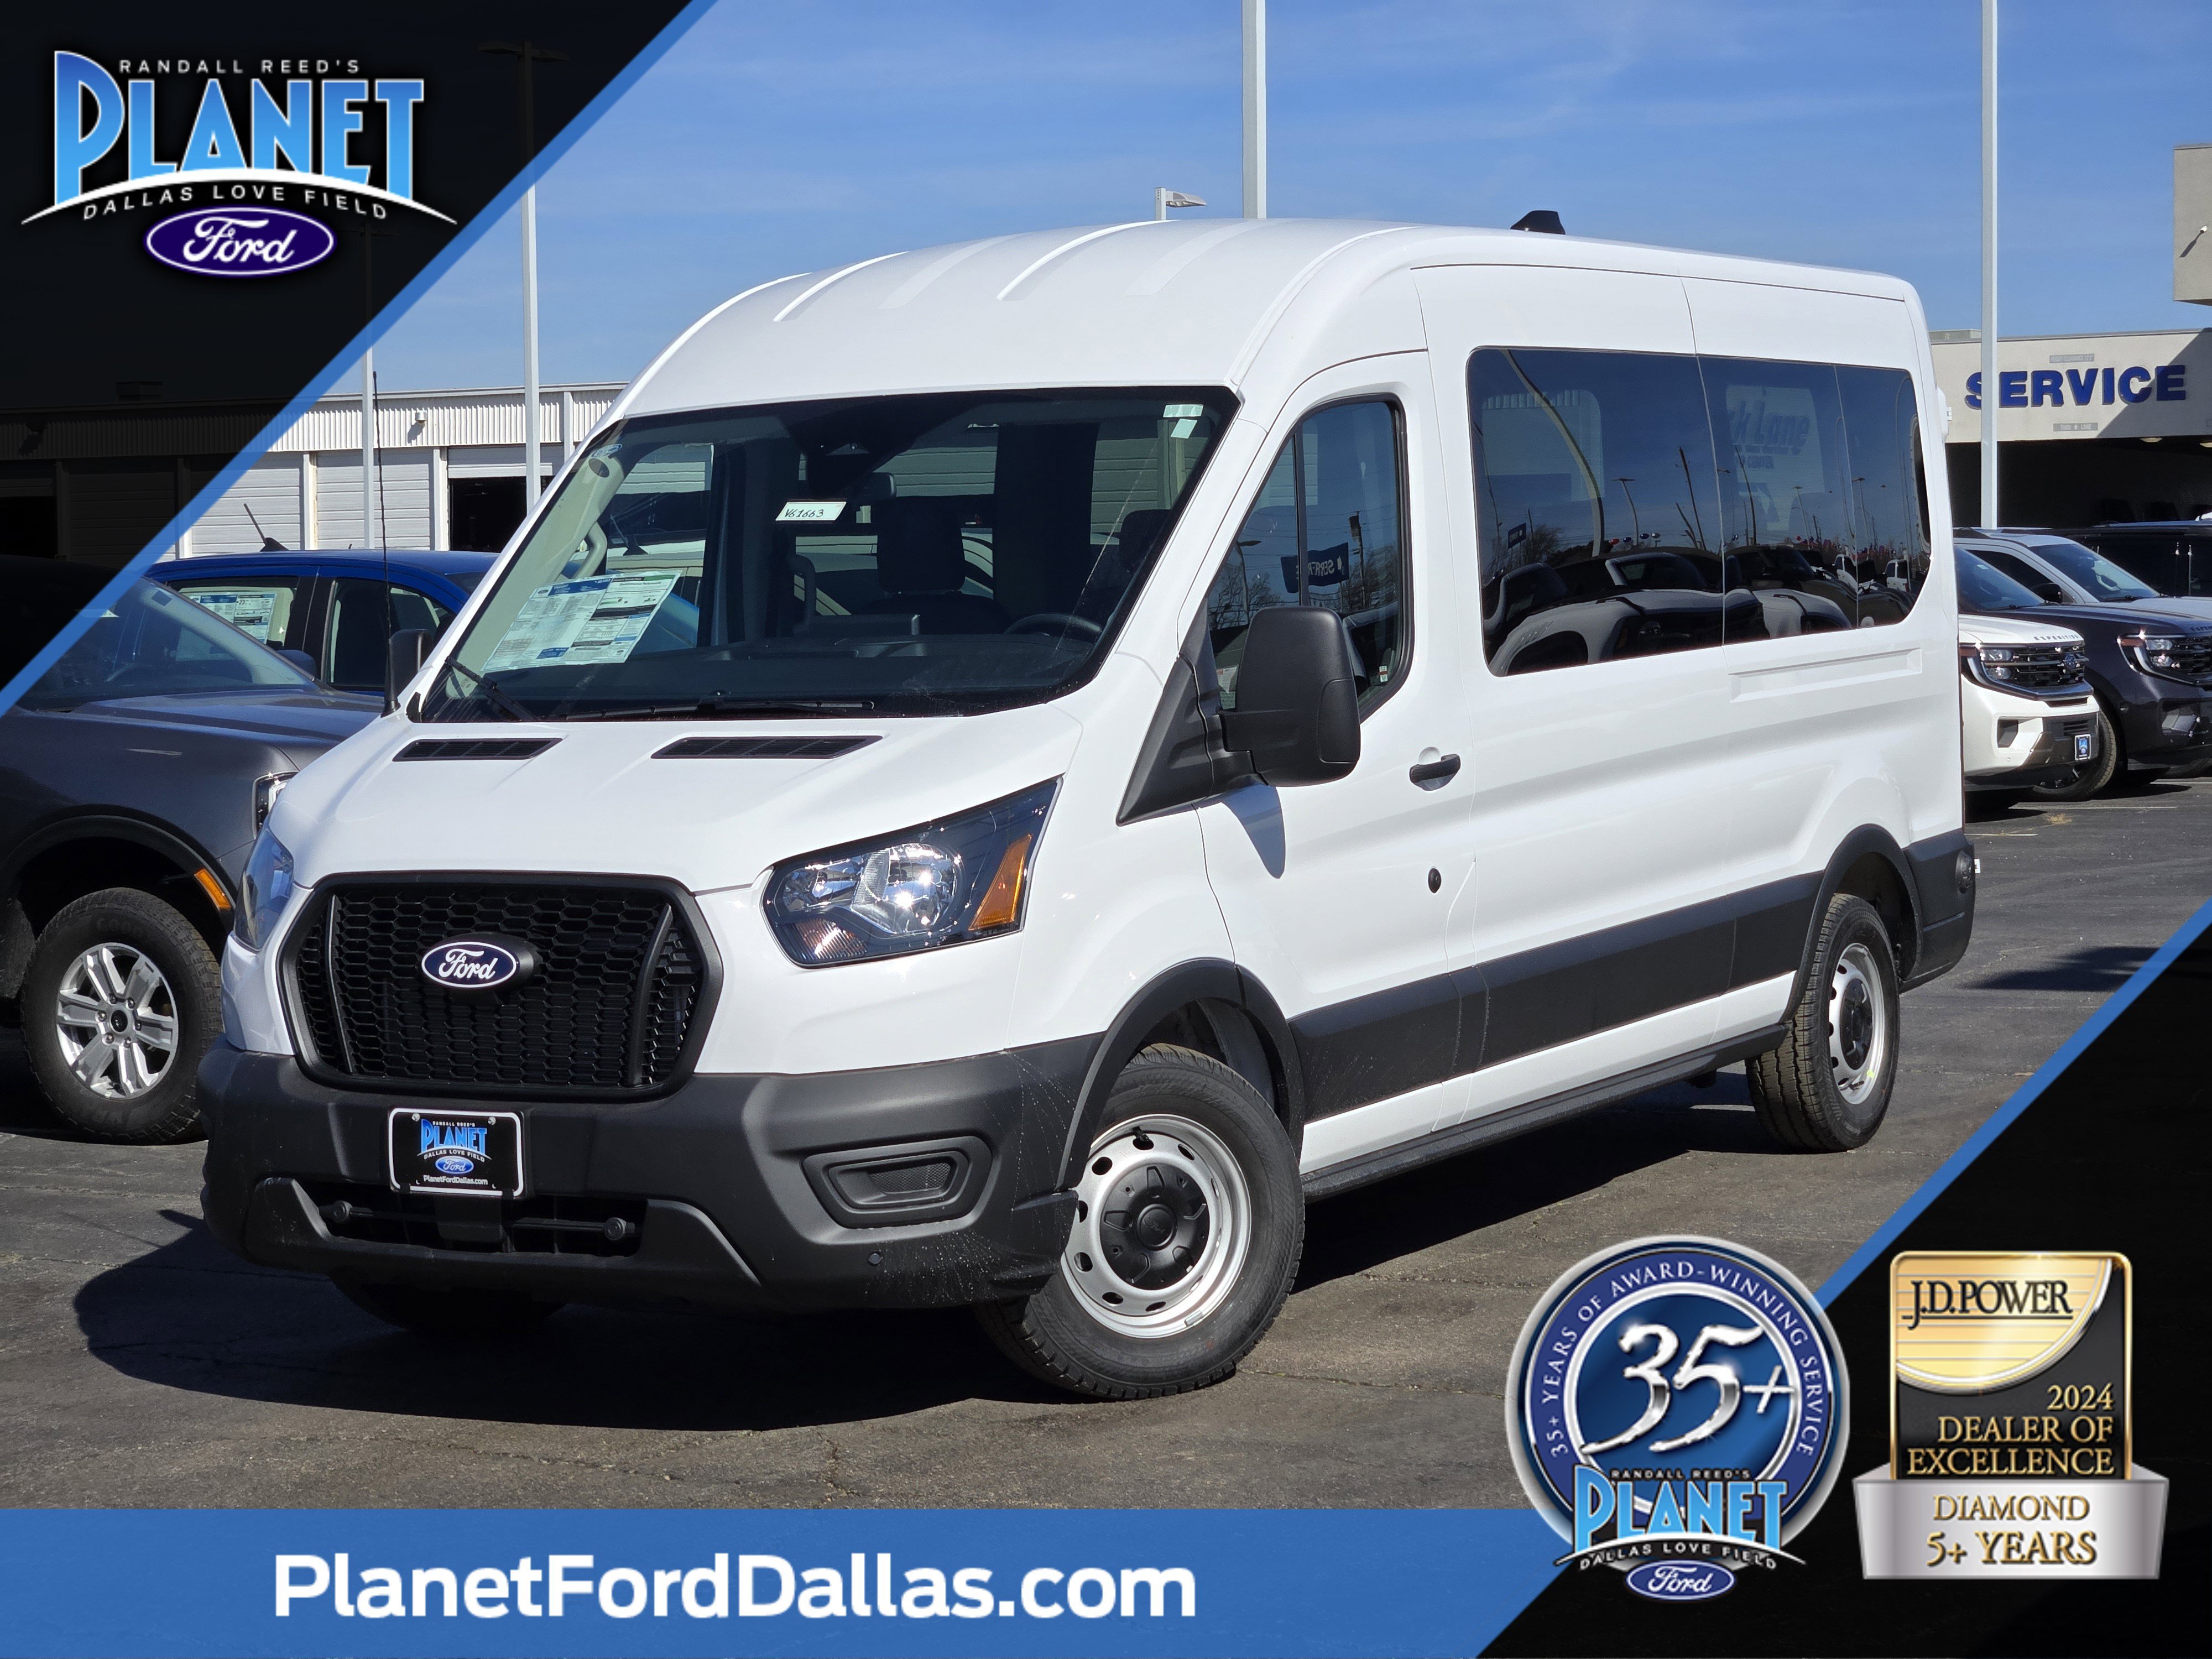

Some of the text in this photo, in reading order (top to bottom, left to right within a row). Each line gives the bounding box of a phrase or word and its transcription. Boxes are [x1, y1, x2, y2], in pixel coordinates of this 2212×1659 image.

[1964, 364, 2186, 410] SERVICE
[438, 948, 499, 980] Ford
[421, 1119, 487, 1155] PLANET
[424, 1150, 447, 1160] DALLAS
[467, 1151, 485, 1162] FIELD
[443, 1159, 466, 1172] Ford
[423, 1175, 488, 1185] PlanetFordDallas.com
